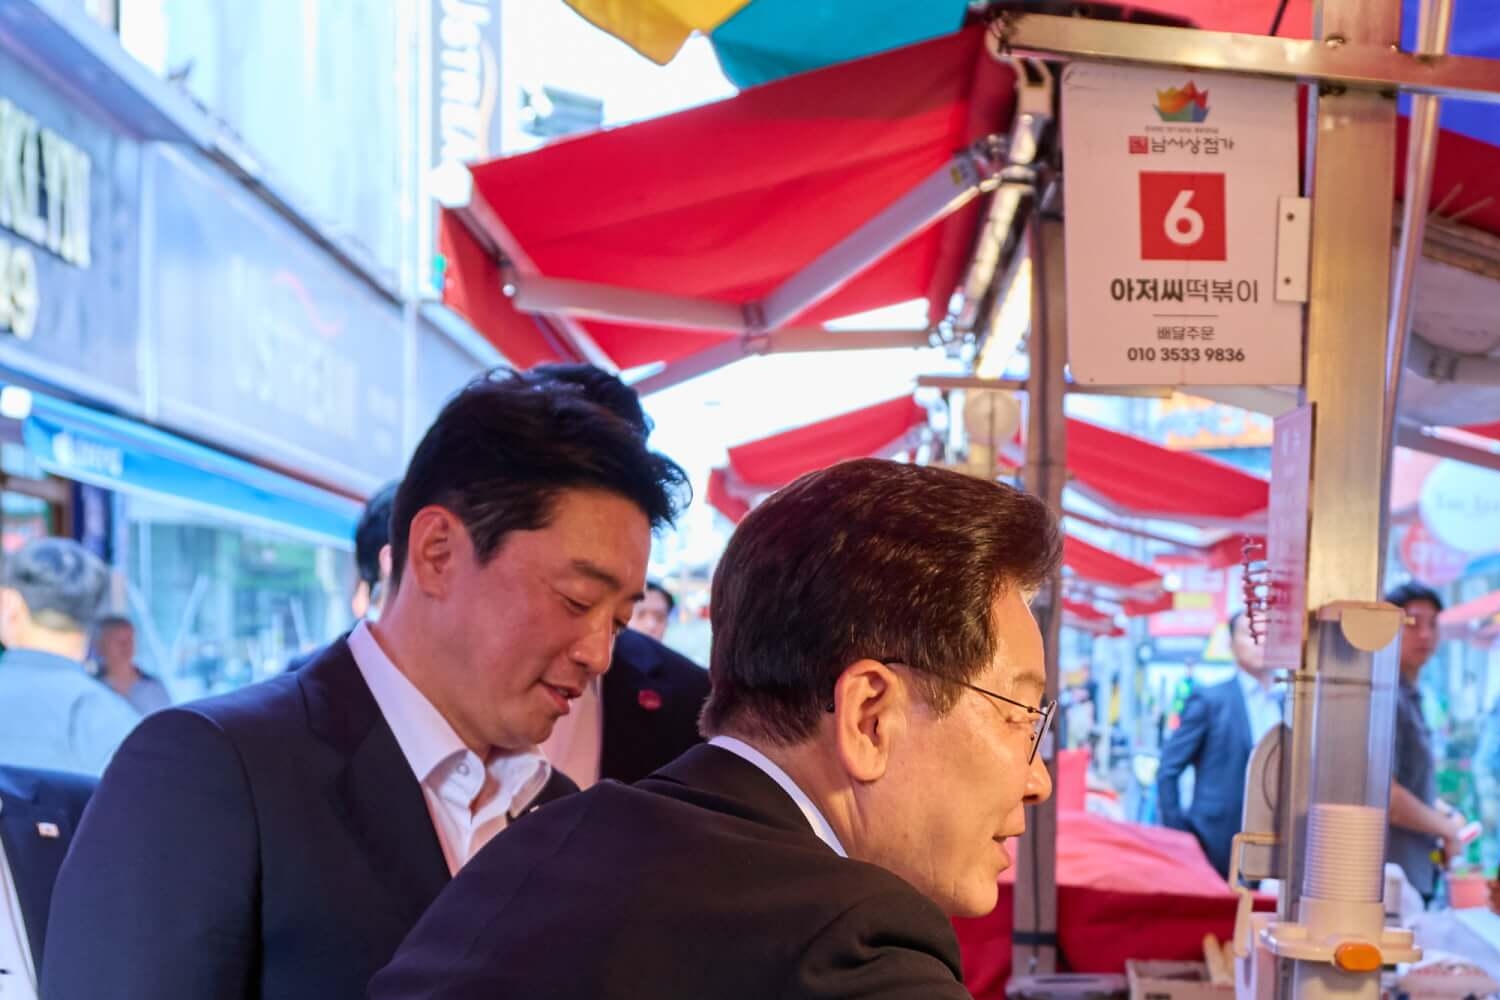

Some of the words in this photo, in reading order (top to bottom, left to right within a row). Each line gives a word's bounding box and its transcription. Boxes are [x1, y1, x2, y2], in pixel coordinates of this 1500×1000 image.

[1151, 135, 1235, 155] 남서상점가
[1163, 189, 1205, 246] 6
[1110, 277, 1259, 303] 아저씨떡볶이
[1156, 325, 1216, 342] 배달주문
[1127, 346, 1156, 362] 010
[1160, 346, 1201, 362] 3533
[1204, 347, 1246, 363] 9836
